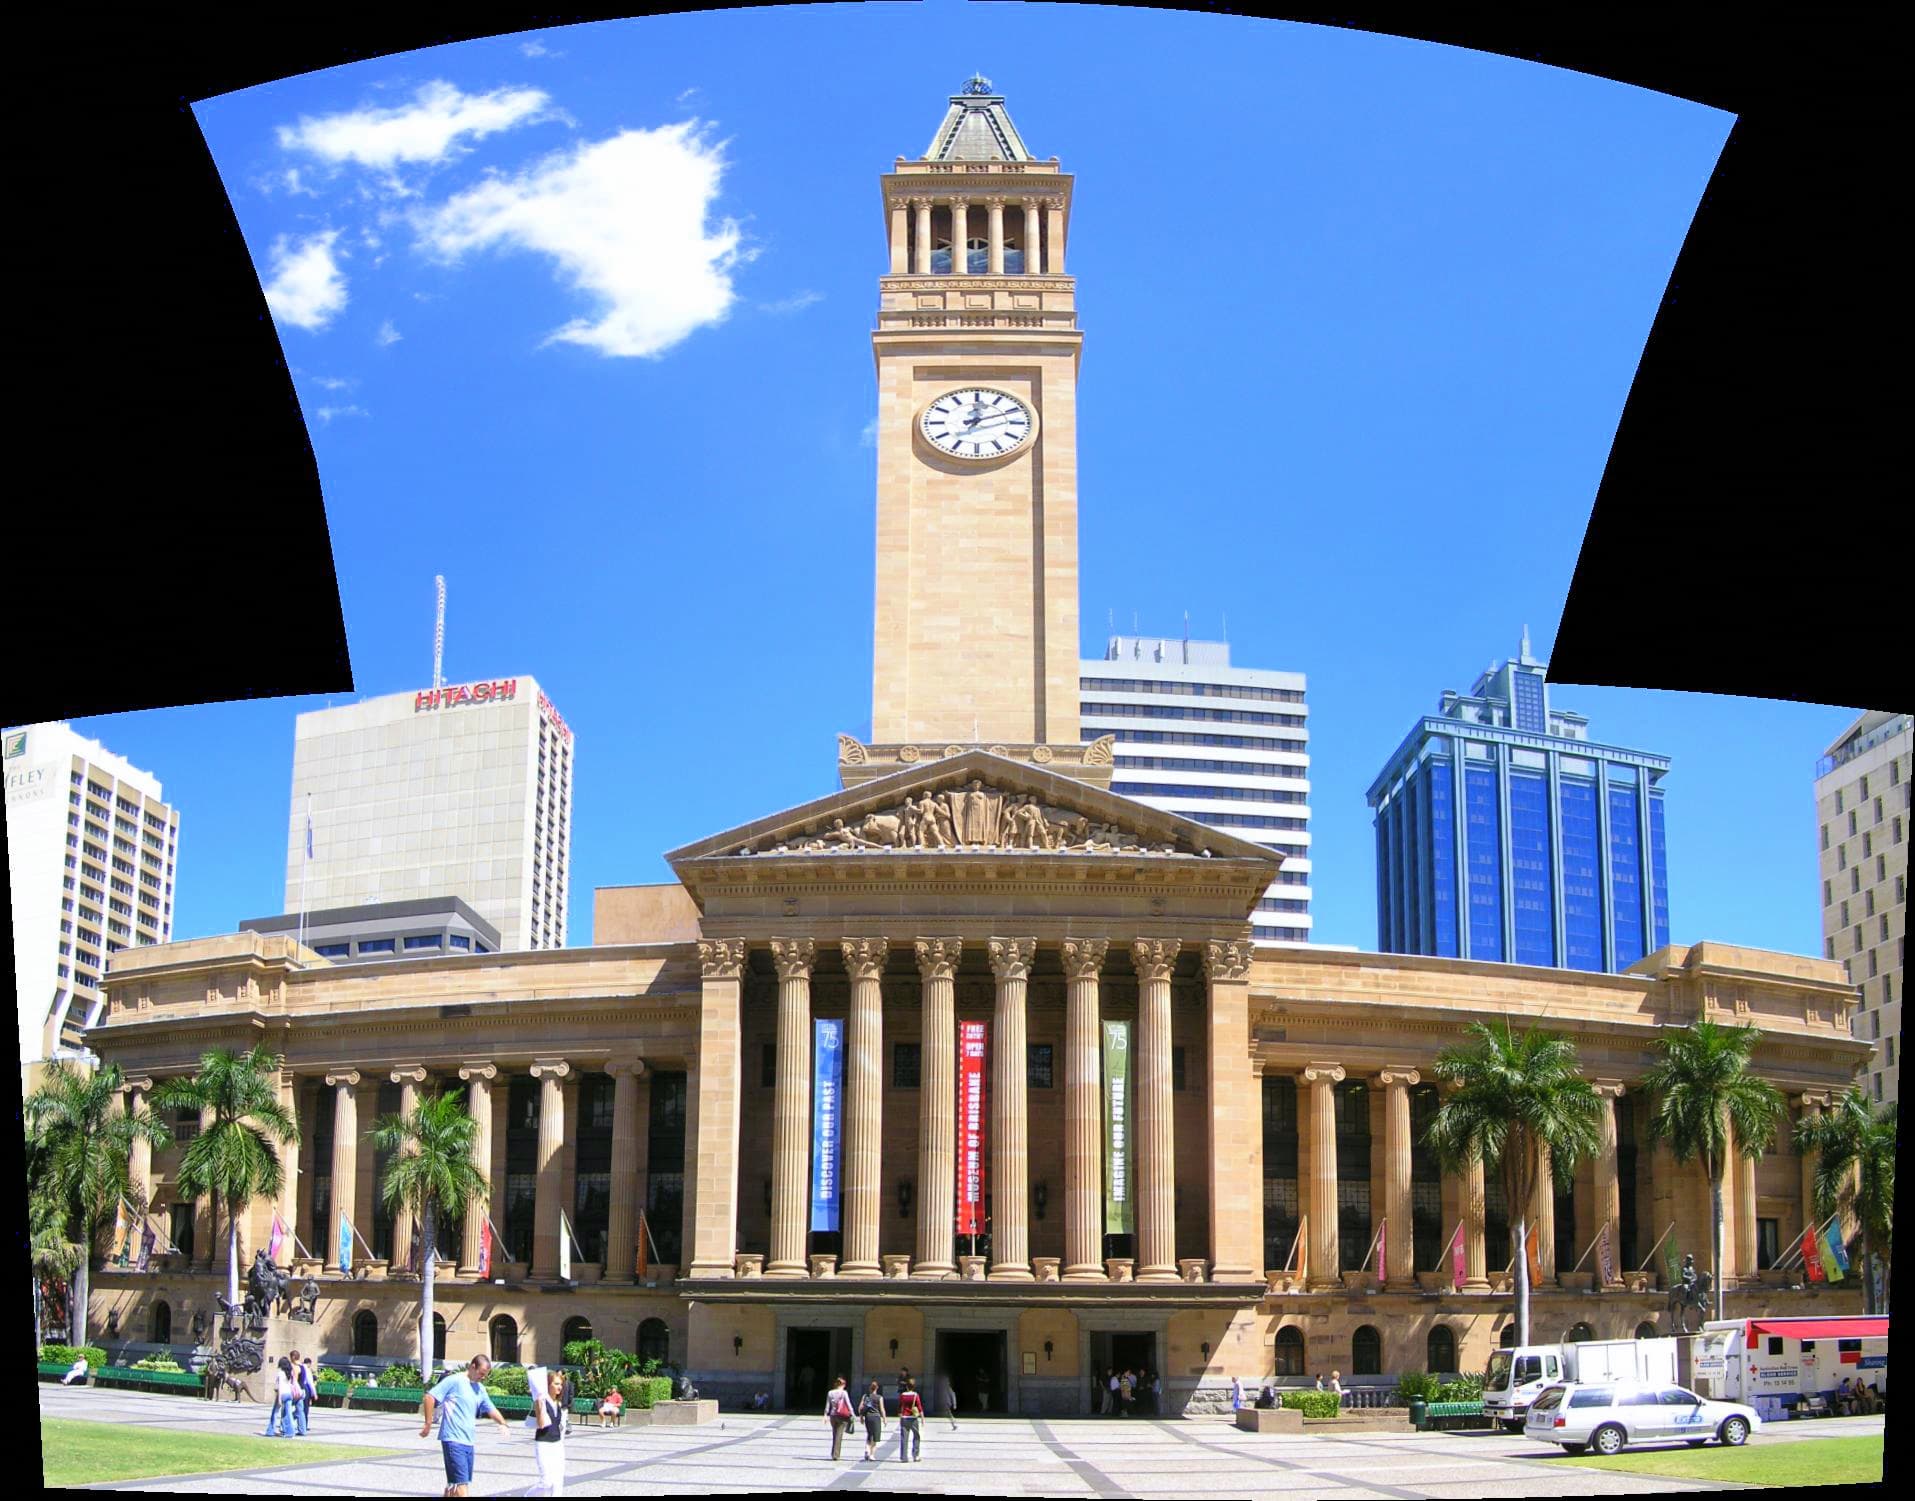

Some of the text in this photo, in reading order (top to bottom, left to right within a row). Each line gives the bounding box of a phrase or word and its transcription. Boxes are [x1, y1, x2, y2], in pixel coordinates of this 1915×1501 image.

[415, 679, 516, 709] HITACHI
[1109, 1032, 1128, 1050] 75
[820, 1080, 835, 1199] DISCOVER OUR PAST
[967, 1071, 981, 1202] MUSEUM OF BRISBANE
[1112, 1077, 1125, 1201] IMAGINE OUR FUTURE
